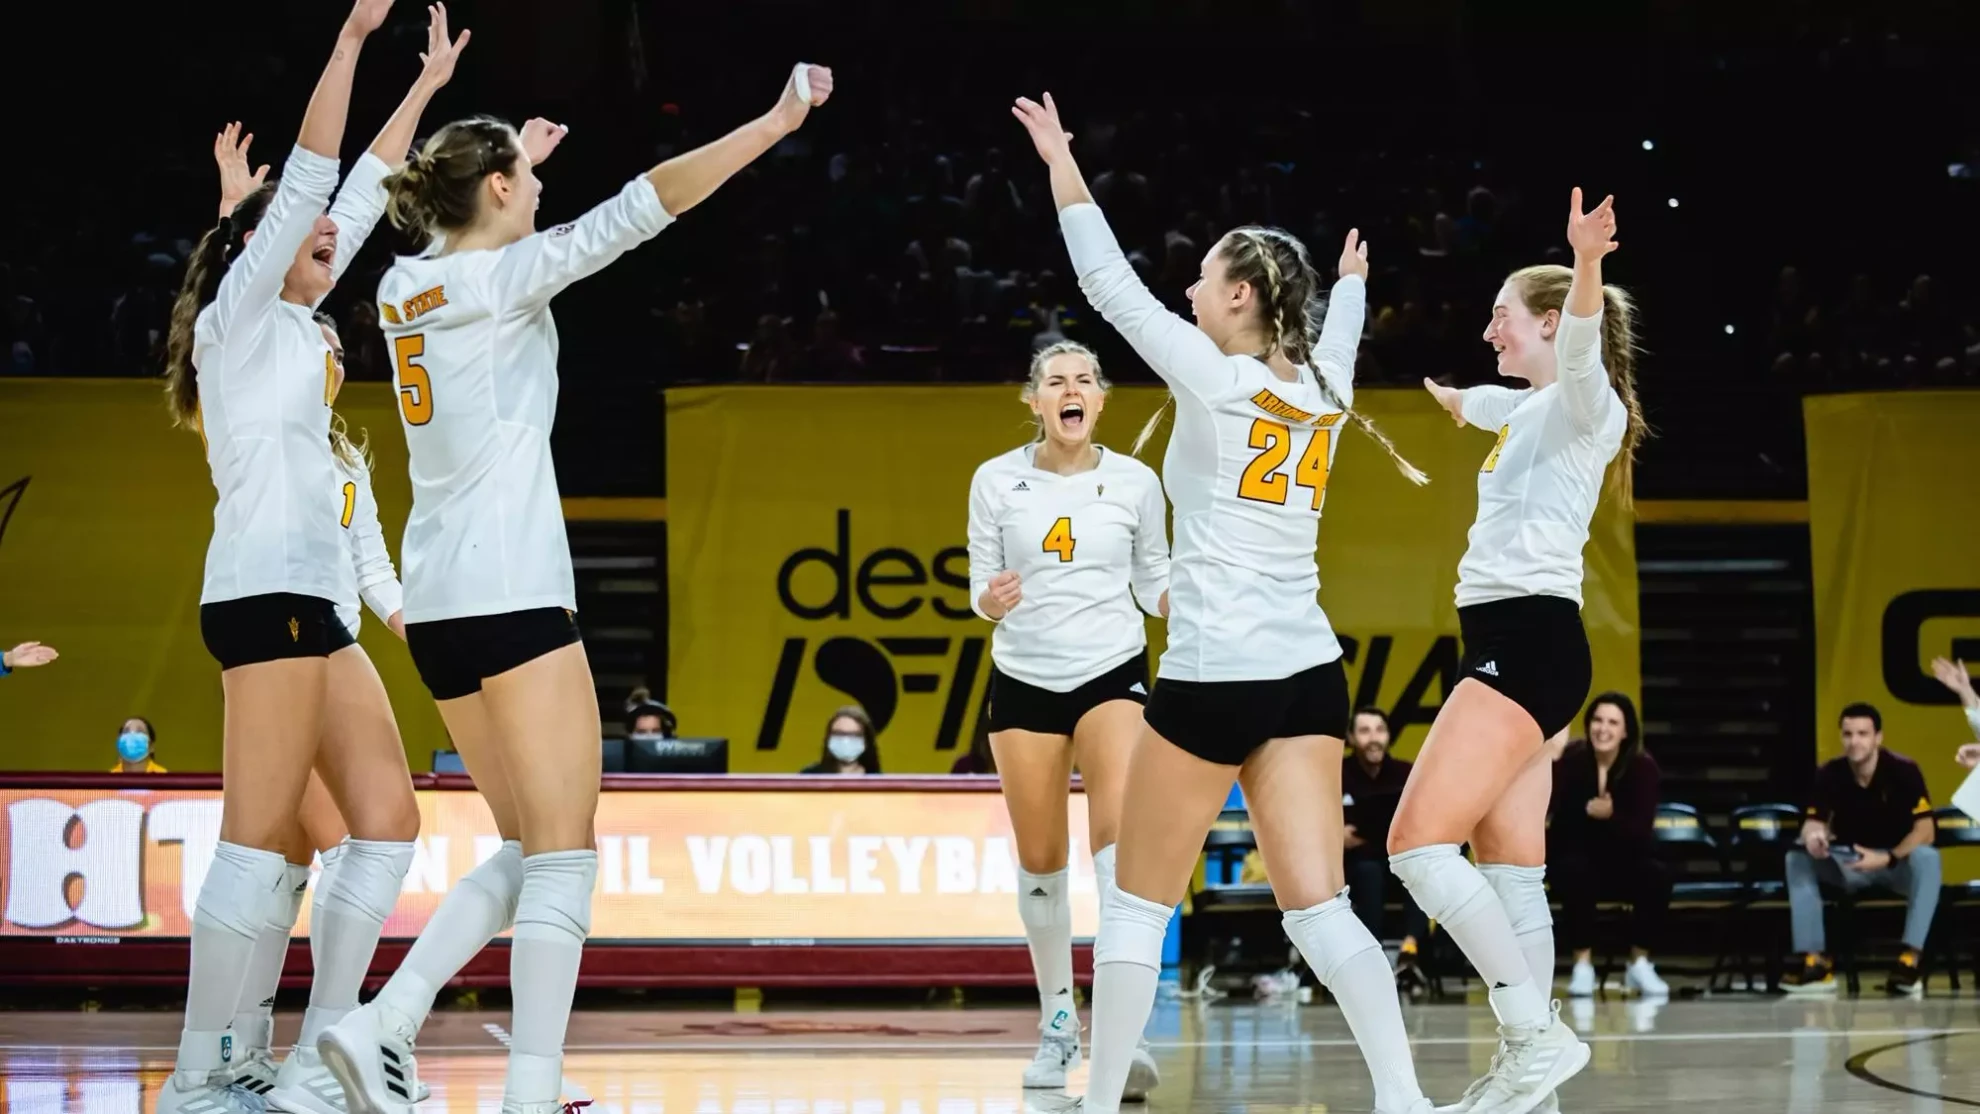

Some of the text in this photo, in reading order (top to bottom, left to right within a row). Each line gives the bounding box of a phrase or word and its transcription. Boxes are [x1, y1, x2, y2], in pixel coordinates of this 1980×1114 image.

[403, 285, 449, 321] STATE
[395, 333, 434, 426] 5
[1237, 418, 1331, 511] 24
[777, 508, 977, 620] des
[1042, 517, 1076, 562] 4
[686, 835, 1099, 894] VOLLEYBAL
[56, 936, 120, 944] DAKTRONICS
